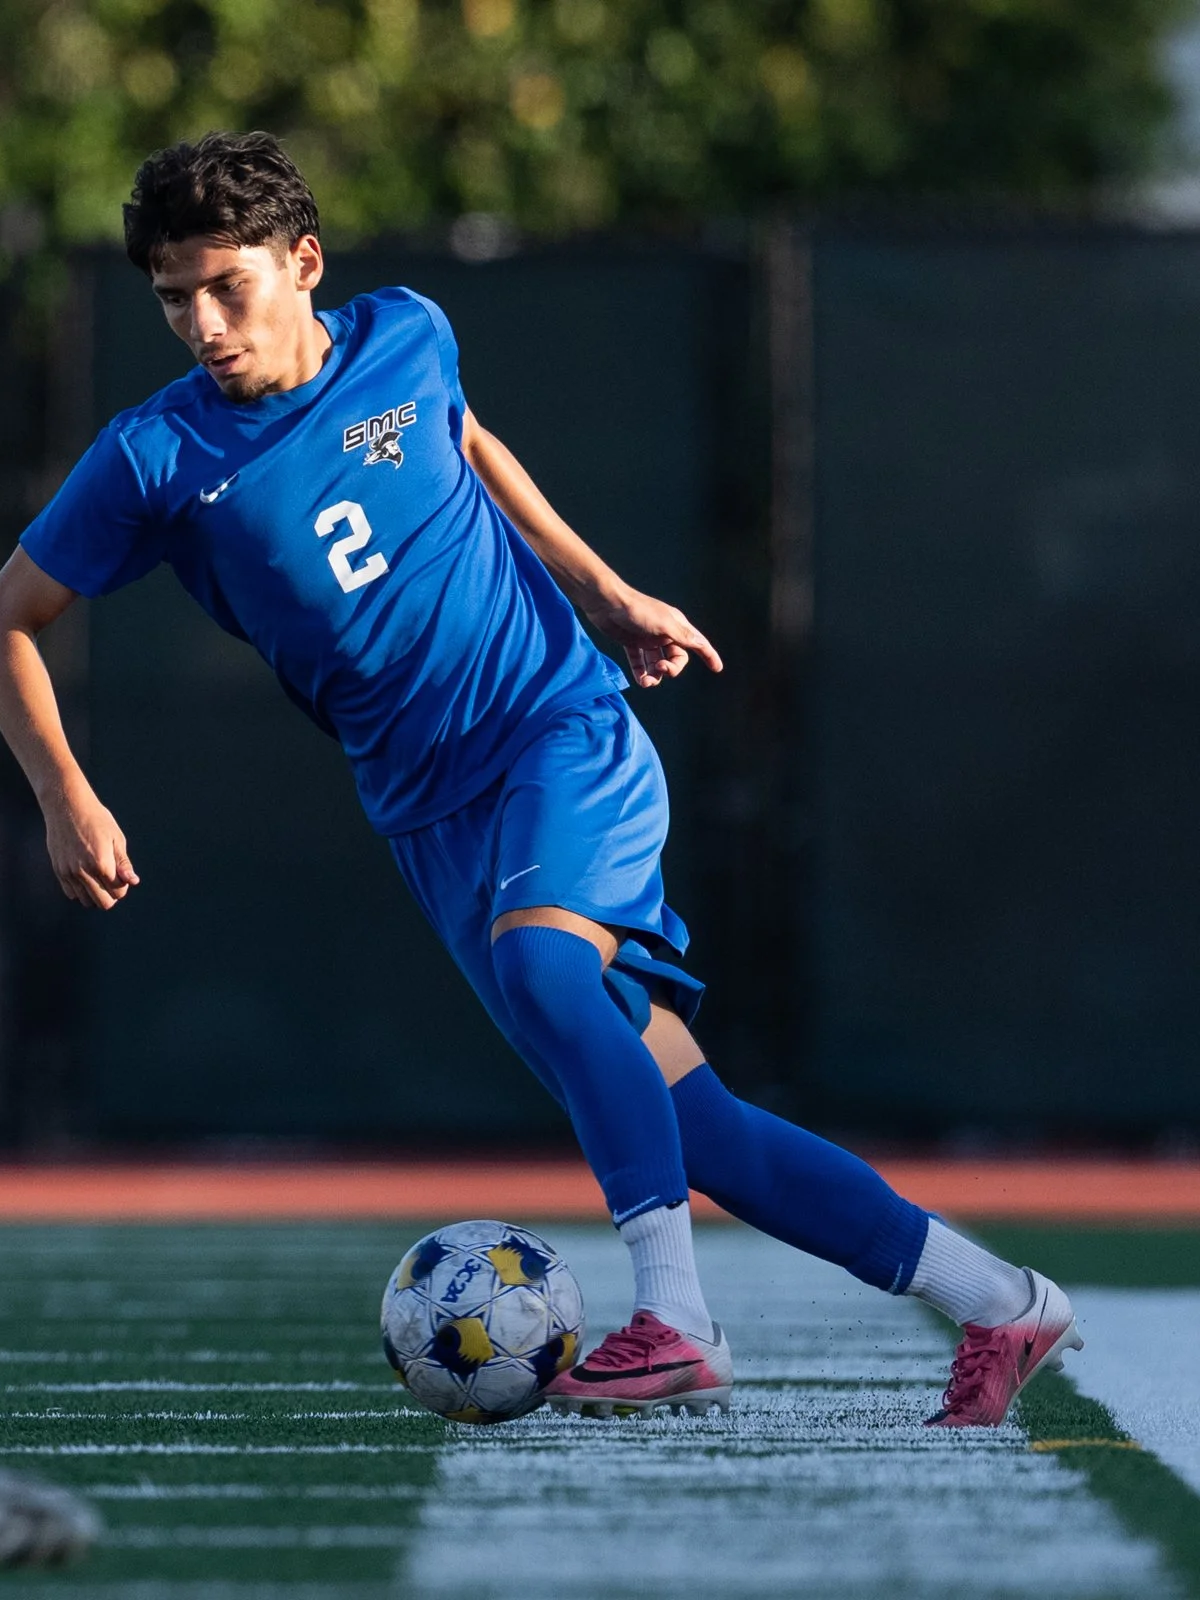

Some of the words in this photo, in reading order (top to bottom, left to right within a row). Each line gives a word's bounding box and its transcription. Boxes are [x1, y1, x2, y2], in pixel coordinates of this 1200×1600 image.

[343, 401, 417, 452] SMC
[314, 500, 389, 593] 2
[440, 1258, 482, 1303] 3C2A
